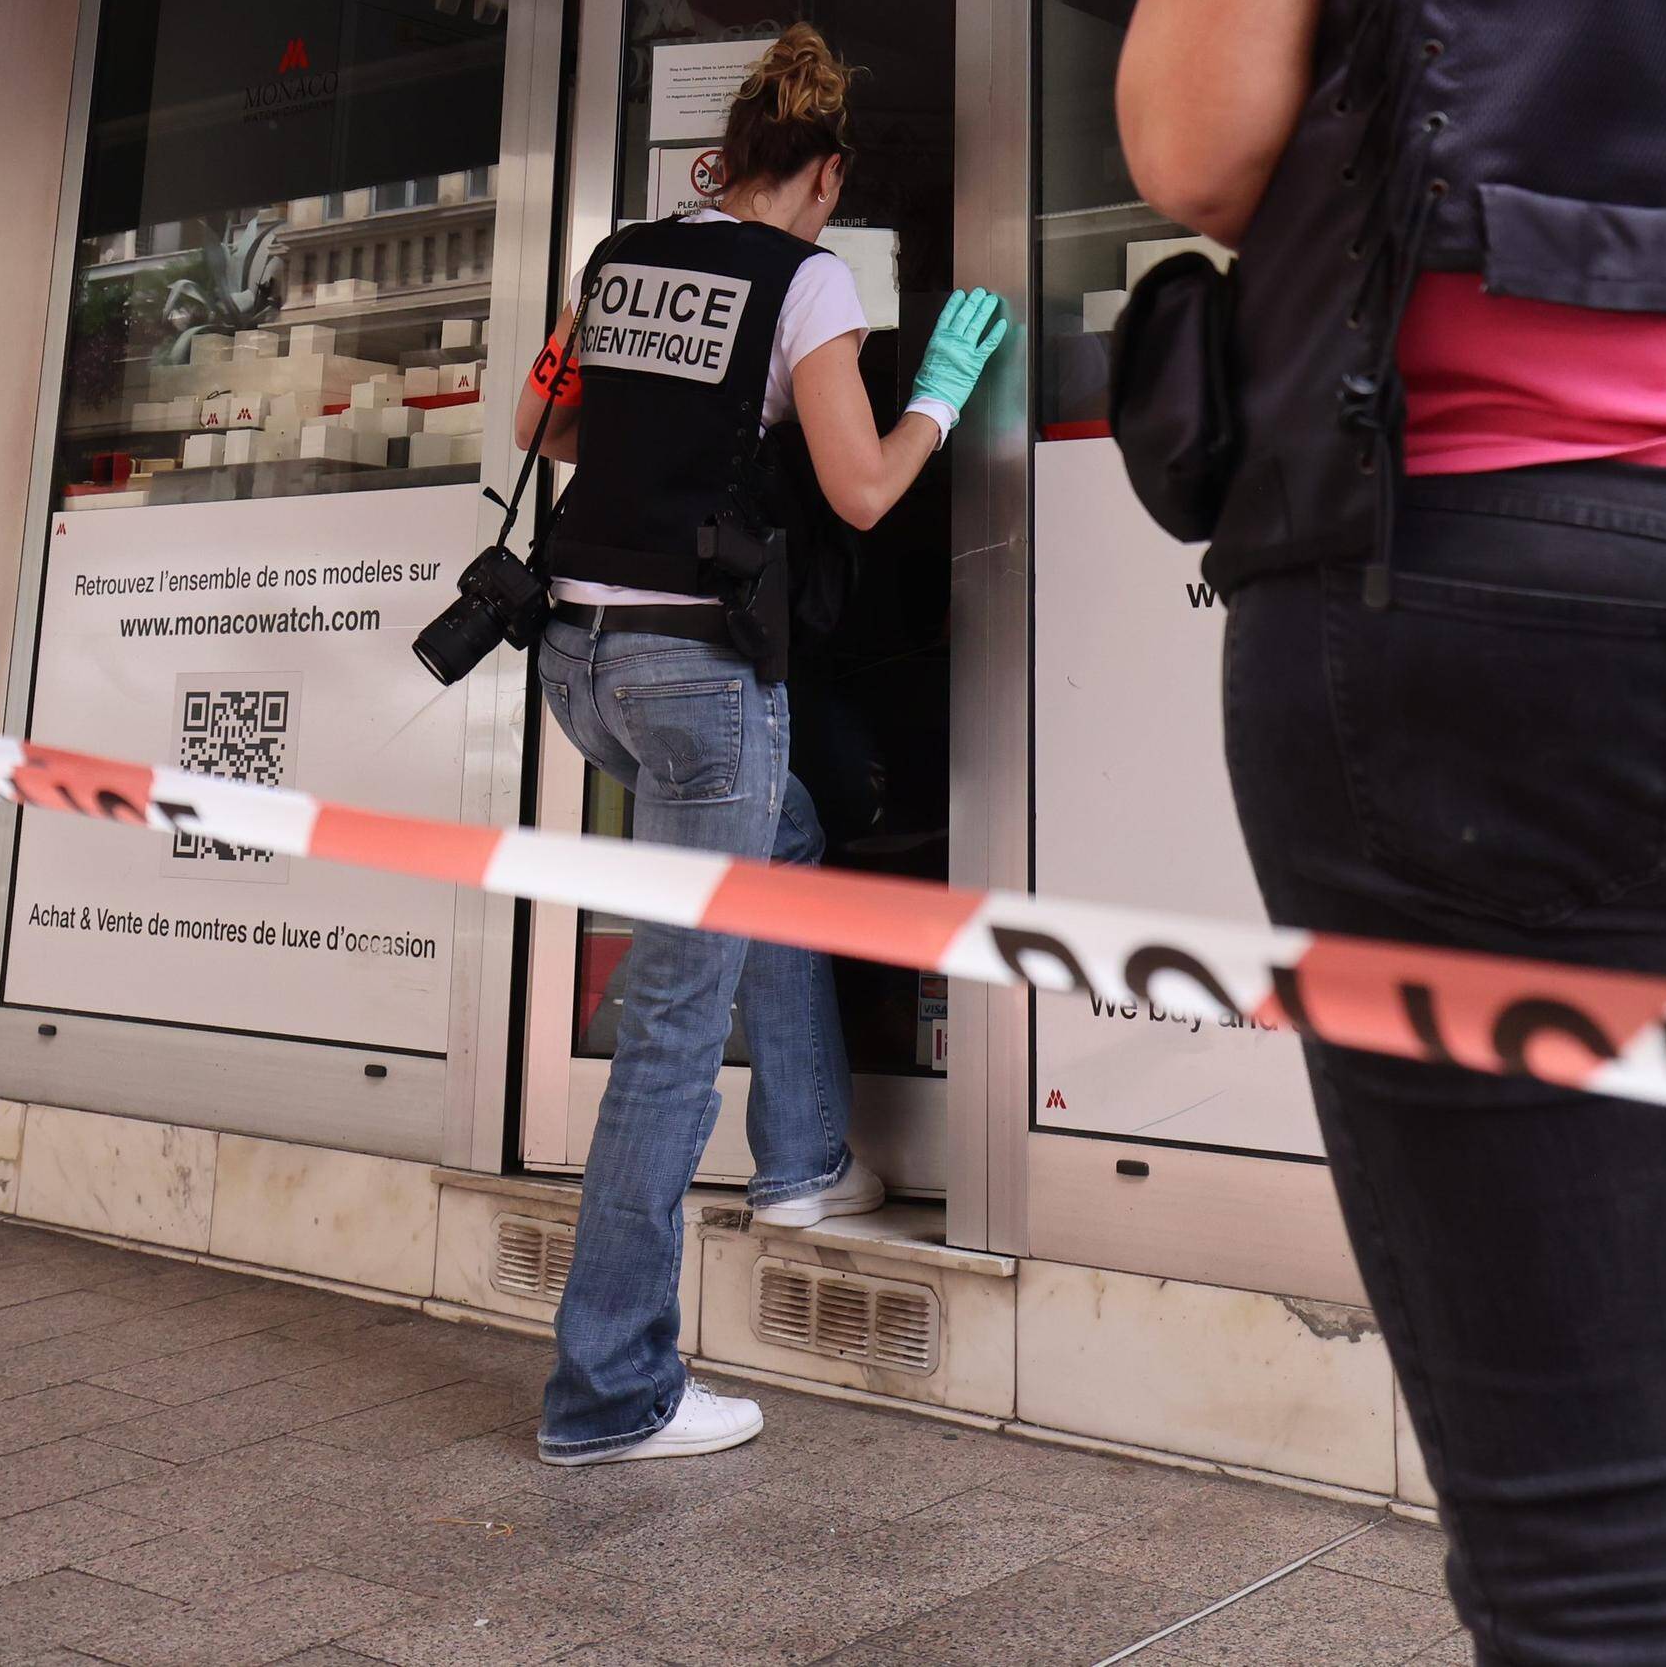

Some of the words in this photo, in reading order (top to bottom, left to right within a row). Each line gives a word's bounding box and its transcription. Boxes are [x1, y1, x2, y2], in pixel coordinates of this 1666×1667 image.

[244, 71, 339, 110] MONACO
[586, 275, 738, 329] POLICE
[580, 325, 723, 370] SCIENTIFIQUE
[75, 574, 154, 596] Retrouvez
[159, 567, 251, 593] l'ensemble
[256, 565, 279, 588] de
[284, 567, 317, 586] nos
[323, 559, 403, 585] modeles
[409, 561, 441, 582] sur
[120, 604, 381, 638] www.monacowatch.com
[29, 903, 76, 929] Achat
[80, 907, 91, 930] &
[97, 908, 143, 934] Vente
[148, 913, 169, 936] de
[175, 918, 247, 944] montres
[253, 921, 276, 946] de
[282, 922, 321, 949] luxe
[327, 925, 436, 959] d'occasion
[1090, 989, 1137, 1020] We
